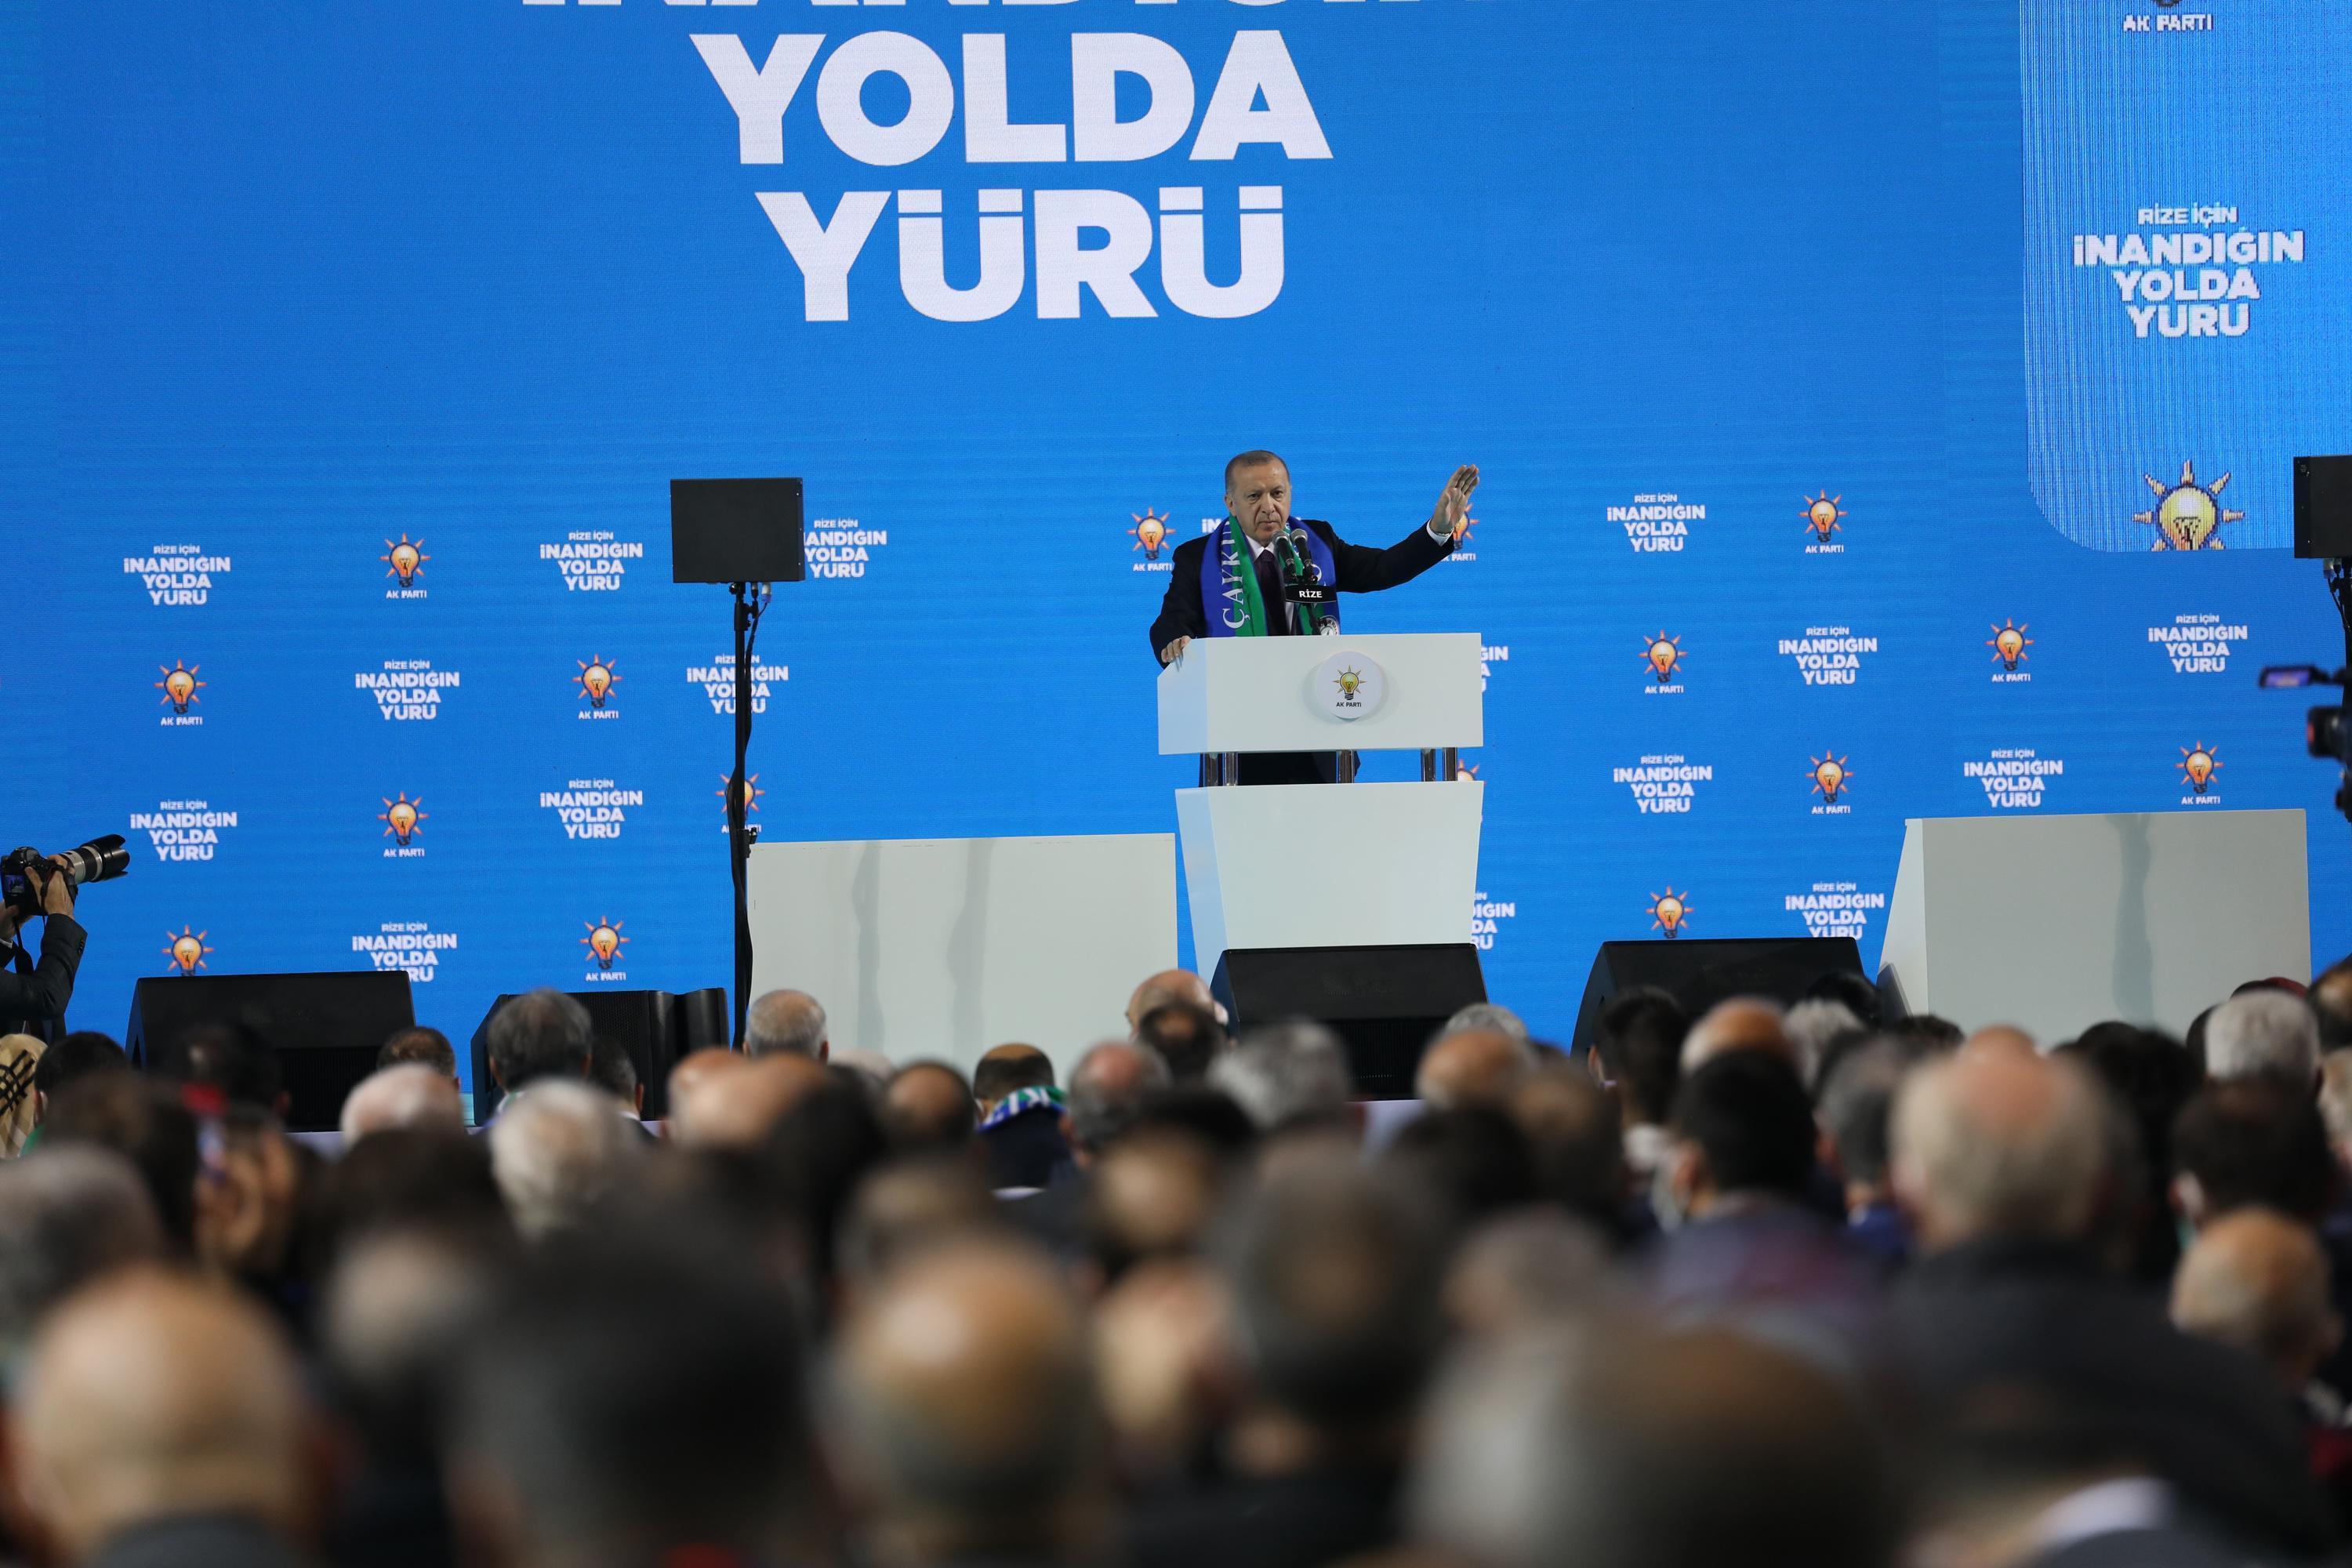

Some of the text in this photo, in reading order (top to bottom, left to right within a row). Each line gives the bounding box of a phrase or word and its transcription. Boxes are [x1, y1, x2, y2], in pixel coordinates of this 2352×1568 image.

[2123, 14, 2150, 31] AK
[688, 30, 1333, 165] YOLDA
[2138, 201, 2238, 228] RİZE İÇİN
[754, 185, 1283, 321] YÜRÜ
[2112, 268, 2260, 302] YOLDA
[1624, 521, 1689, 536] YOLDA
[804, 546, 869, 562] YOLDA
[1805, 545, 1817, 554] AK
[557, 559, 625, 575] YOLDA
[142, 574, 212, 590] YOLDA
[386, 590, 399, 598] AK
[1298, 589, 1323, 598] RİZE
[2165, 642, 2230, 657] YOLDA
[1795, 654, 1860, 670] YOLDA
[1991, 673, 2004, 682] AK
[374, 689, 441, 704] YOLDA
[1644, 685, 1657, 694] AK
[161, 717, 173, 726] AK
[579, 711, 591, 720] AK
[1631, 782, 1694, 797] YOLDA
[1981, 777, 2045, 792] YOLDA
[557, 808, 625, 823] YOLDA
[150, 829, 219, 845] YOLDA
[383, 848, 397, 857] AK
[1802, 909, 1867, 925] YOLDA
[370, 950, 438, 967] YOLDA
[586, 972, 598, 981] AK
